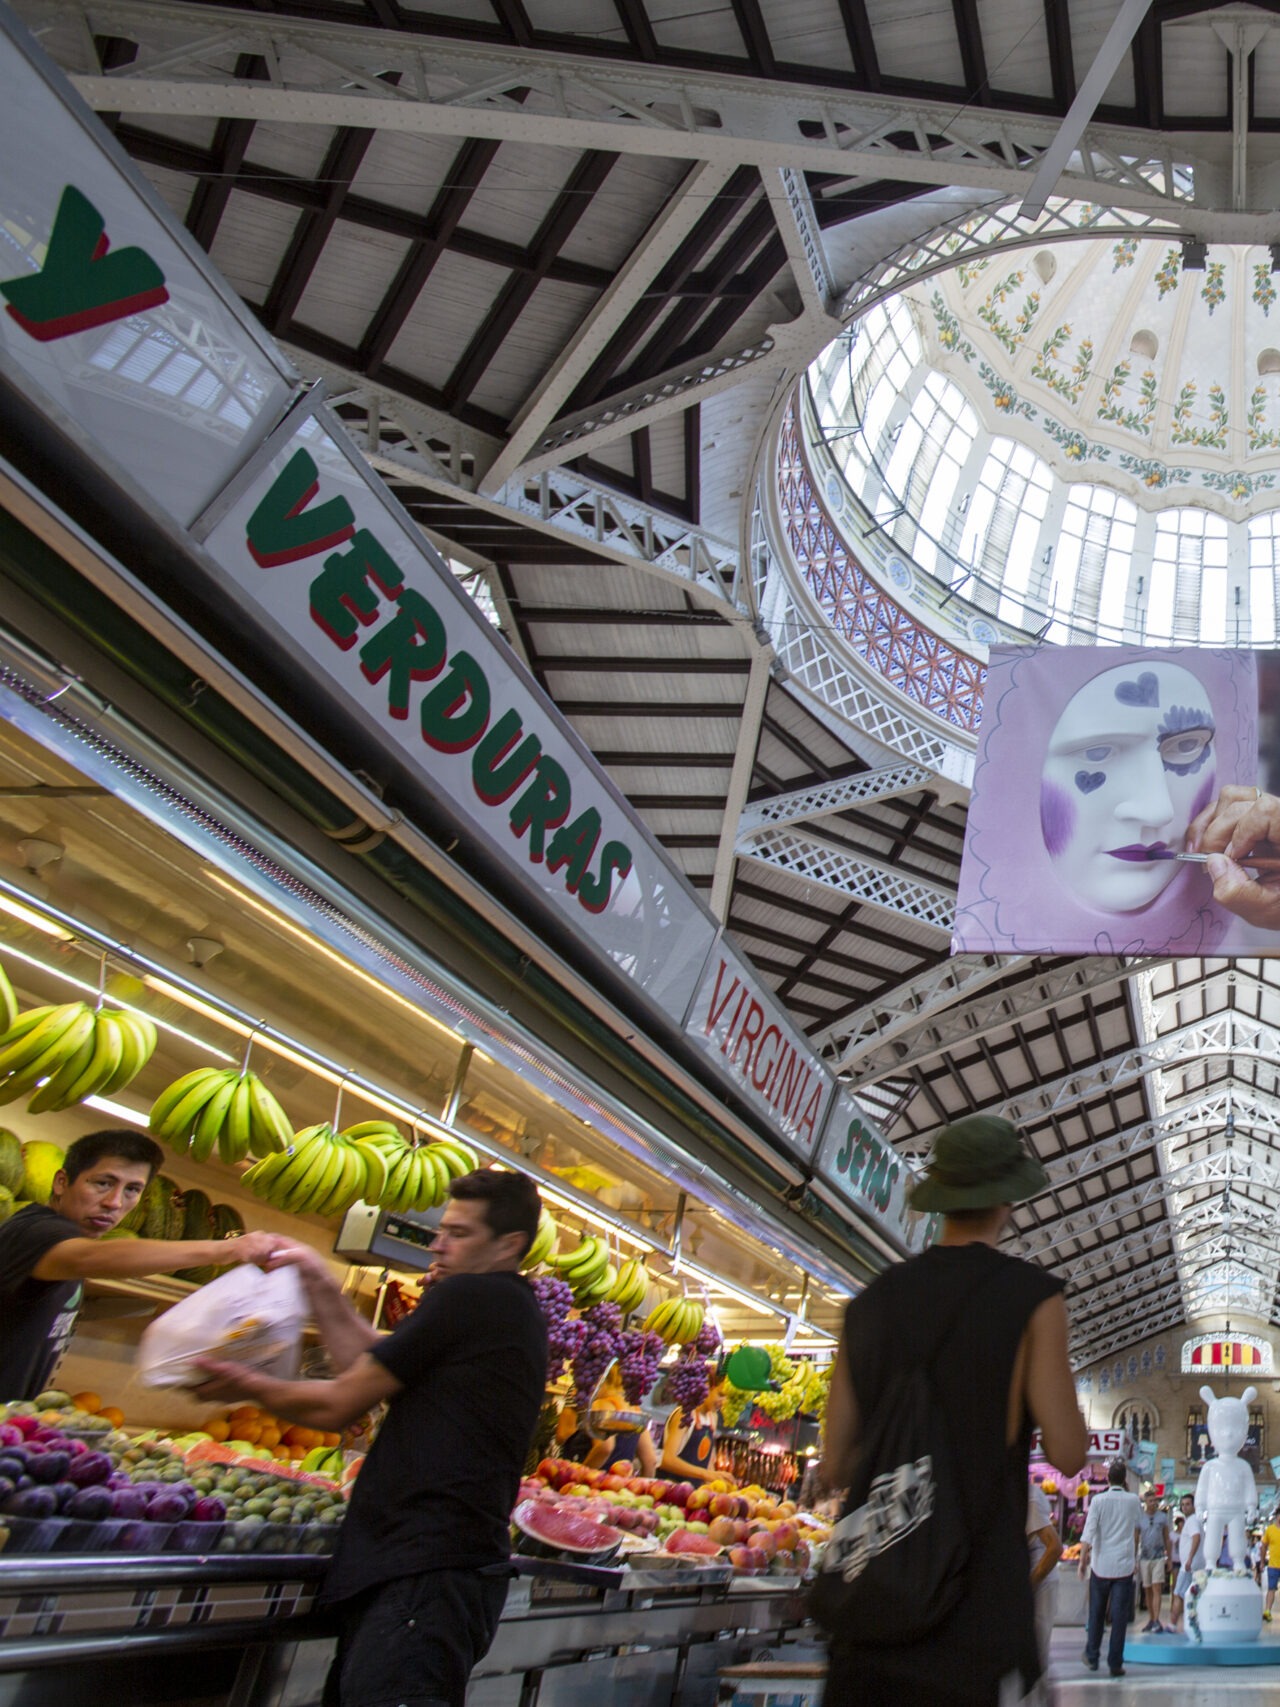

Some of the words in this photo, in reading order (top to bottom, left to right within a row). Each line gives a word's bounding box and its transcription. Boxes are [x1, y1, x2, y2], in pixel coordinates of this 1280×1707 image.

[0, 183, 170, 342] Y
[245, 446, 632, 915] VERDURAS
[703, 959, 824, 1145] VIRGINIA
